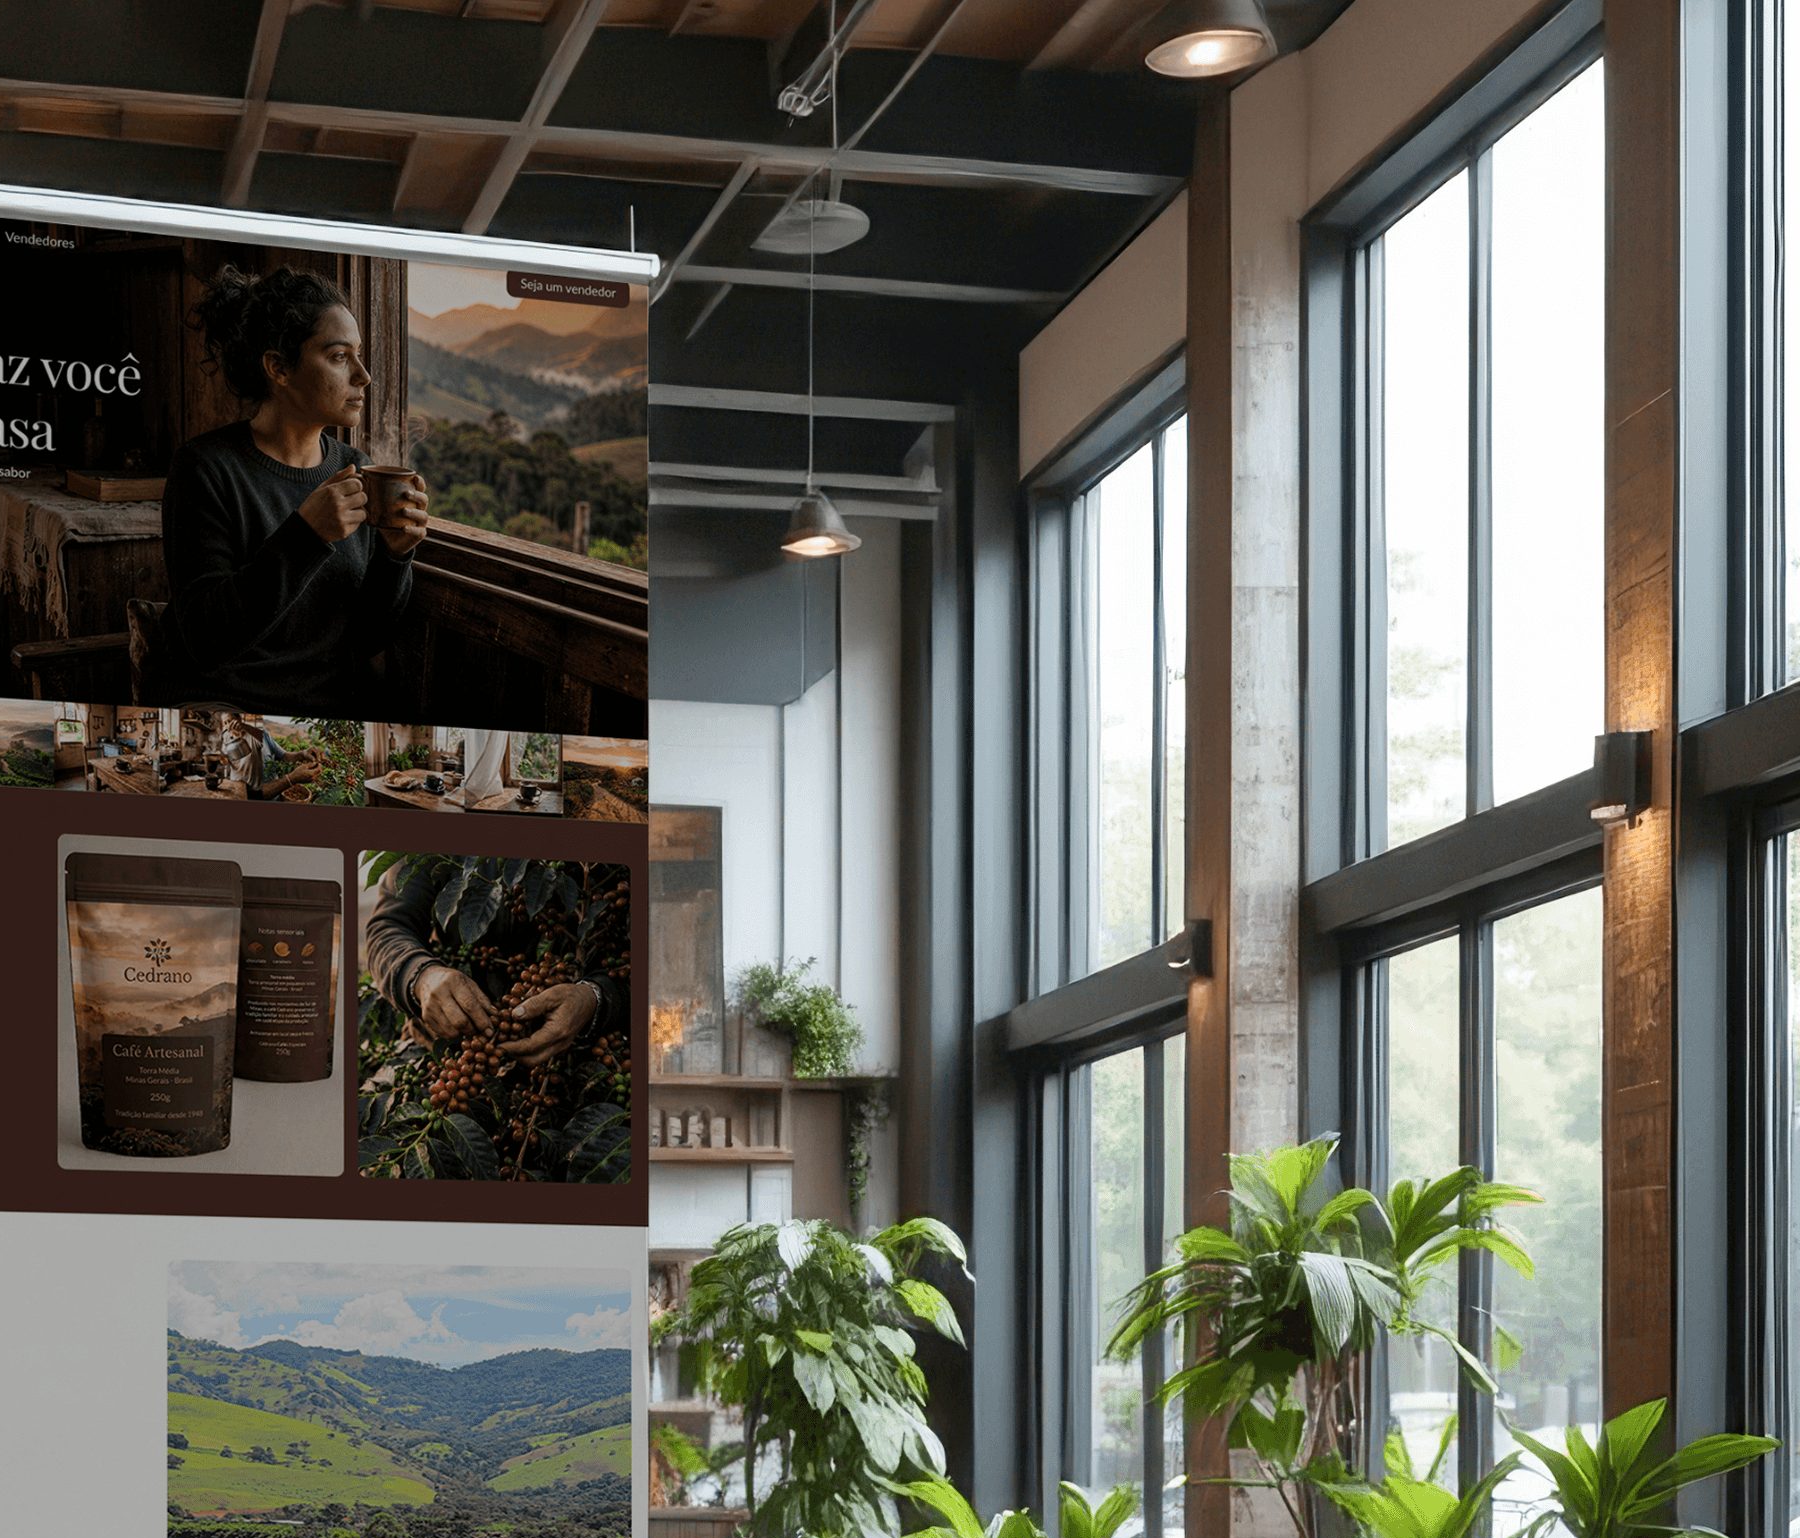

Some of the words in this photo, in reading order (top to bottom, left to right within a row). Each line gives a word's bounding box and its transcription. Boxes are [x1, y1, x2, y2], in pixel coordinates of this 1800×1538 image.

[4, 231, 75, 249] Vendedores
[520, 278, 543, 292] Seja
[545, 283, 563, 293] um
[565, 285, 617, 298] vendedor
[40, 352, 141, 396] você
[123, 966, 192, 983] Cedrano
[112, 1043, 142, 1058] Café
[144, 1044, 204, 1059] Artesanal
[150, 1092, 171, 1103] 250g
